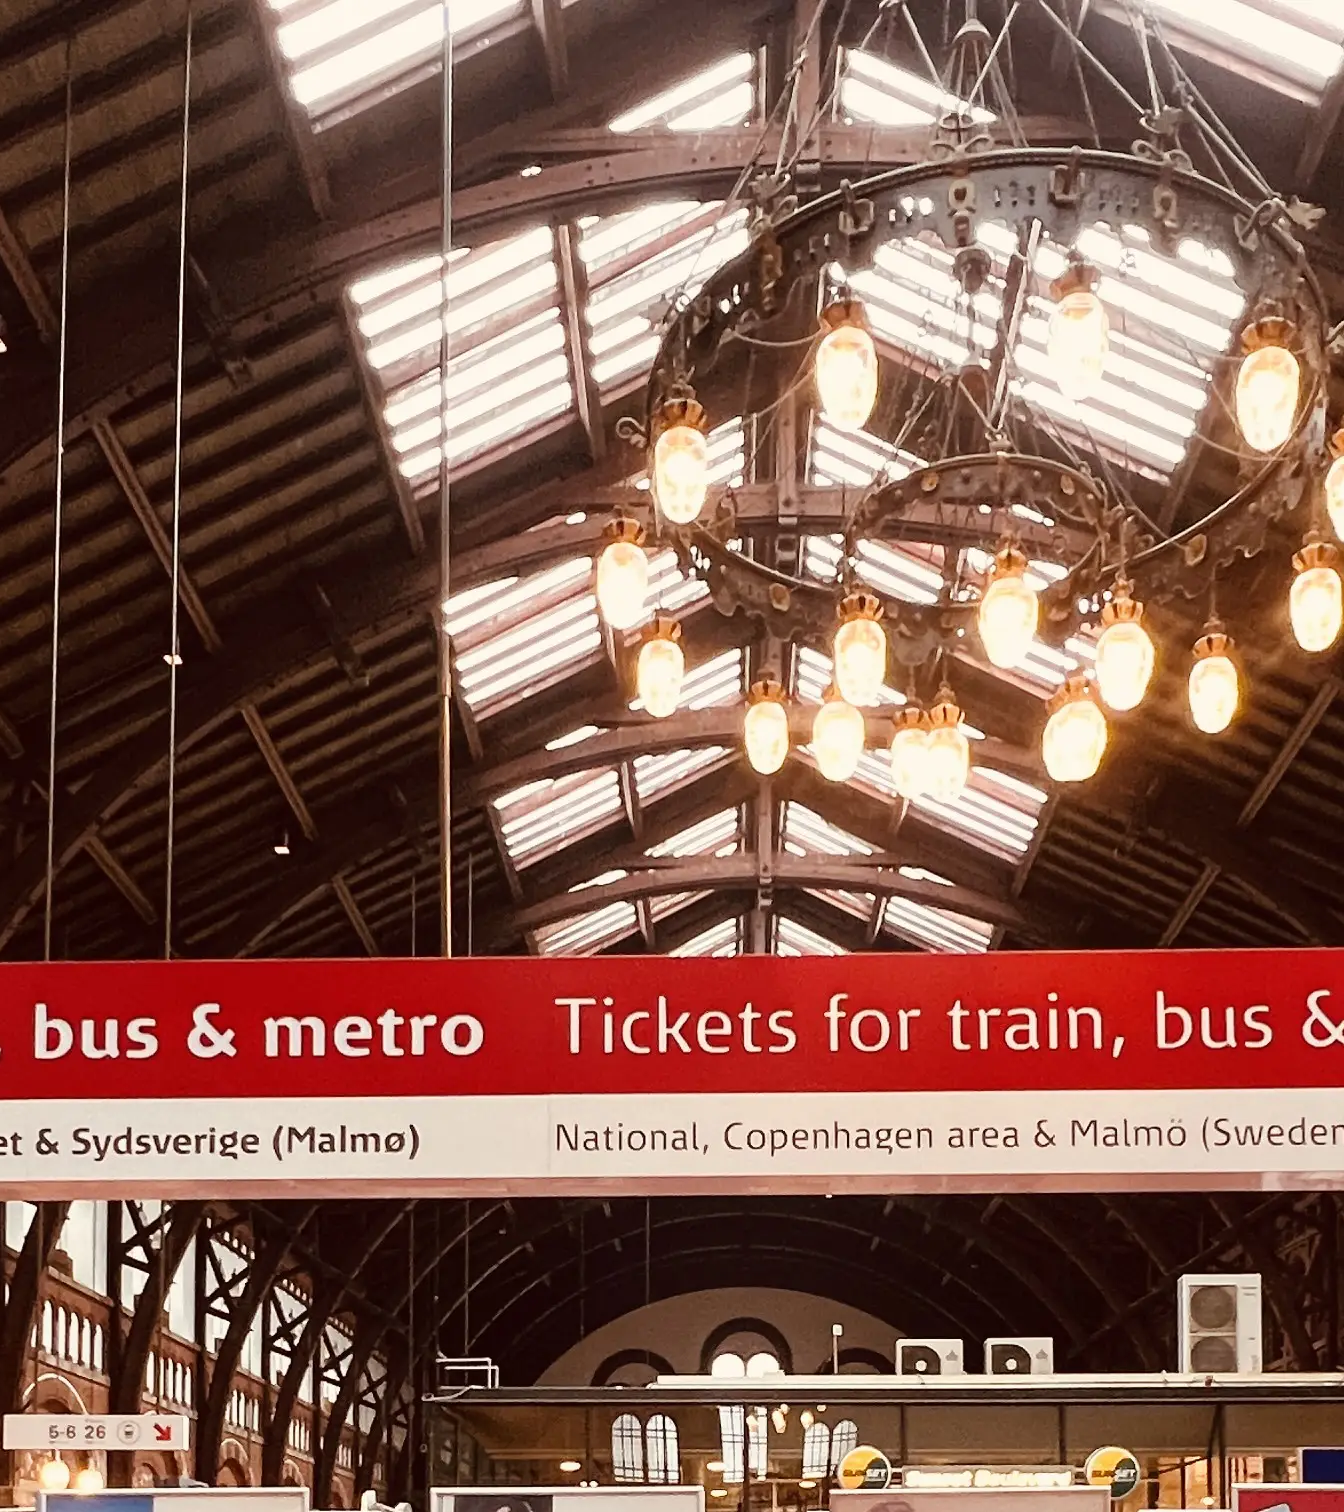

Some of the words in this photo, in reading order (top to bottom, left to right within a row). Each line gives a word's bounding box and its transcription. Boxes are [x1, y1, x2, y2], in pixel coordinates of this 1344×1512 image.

[35, 1004, 158, 1059] bus
[188, 1004, 236, 1057] &
[264, 1009, 483, 1056] metro
[555, 996, 796, 1053] Tickets
[824, 994, 920, 1051] for
[947, 993, 1124, 1058] train,
[1157, 991, 1272, 1048] bus
[36, 1129, 58, 1155] &
[72, 1127, 259, 1161] Sydsverige
[273, 1124, 419, 1161] (Malmø)
[557, 1122, 708, 1155] National,
[725, 1122, 932, 1157] Copenhagen
[949, 1127, 1019, 1148] area
[1035, 1120, 1056, 1147] &
[1072, 1119, 1186, 1147] Malmö
[84, 1425, 106, 1439] 26
